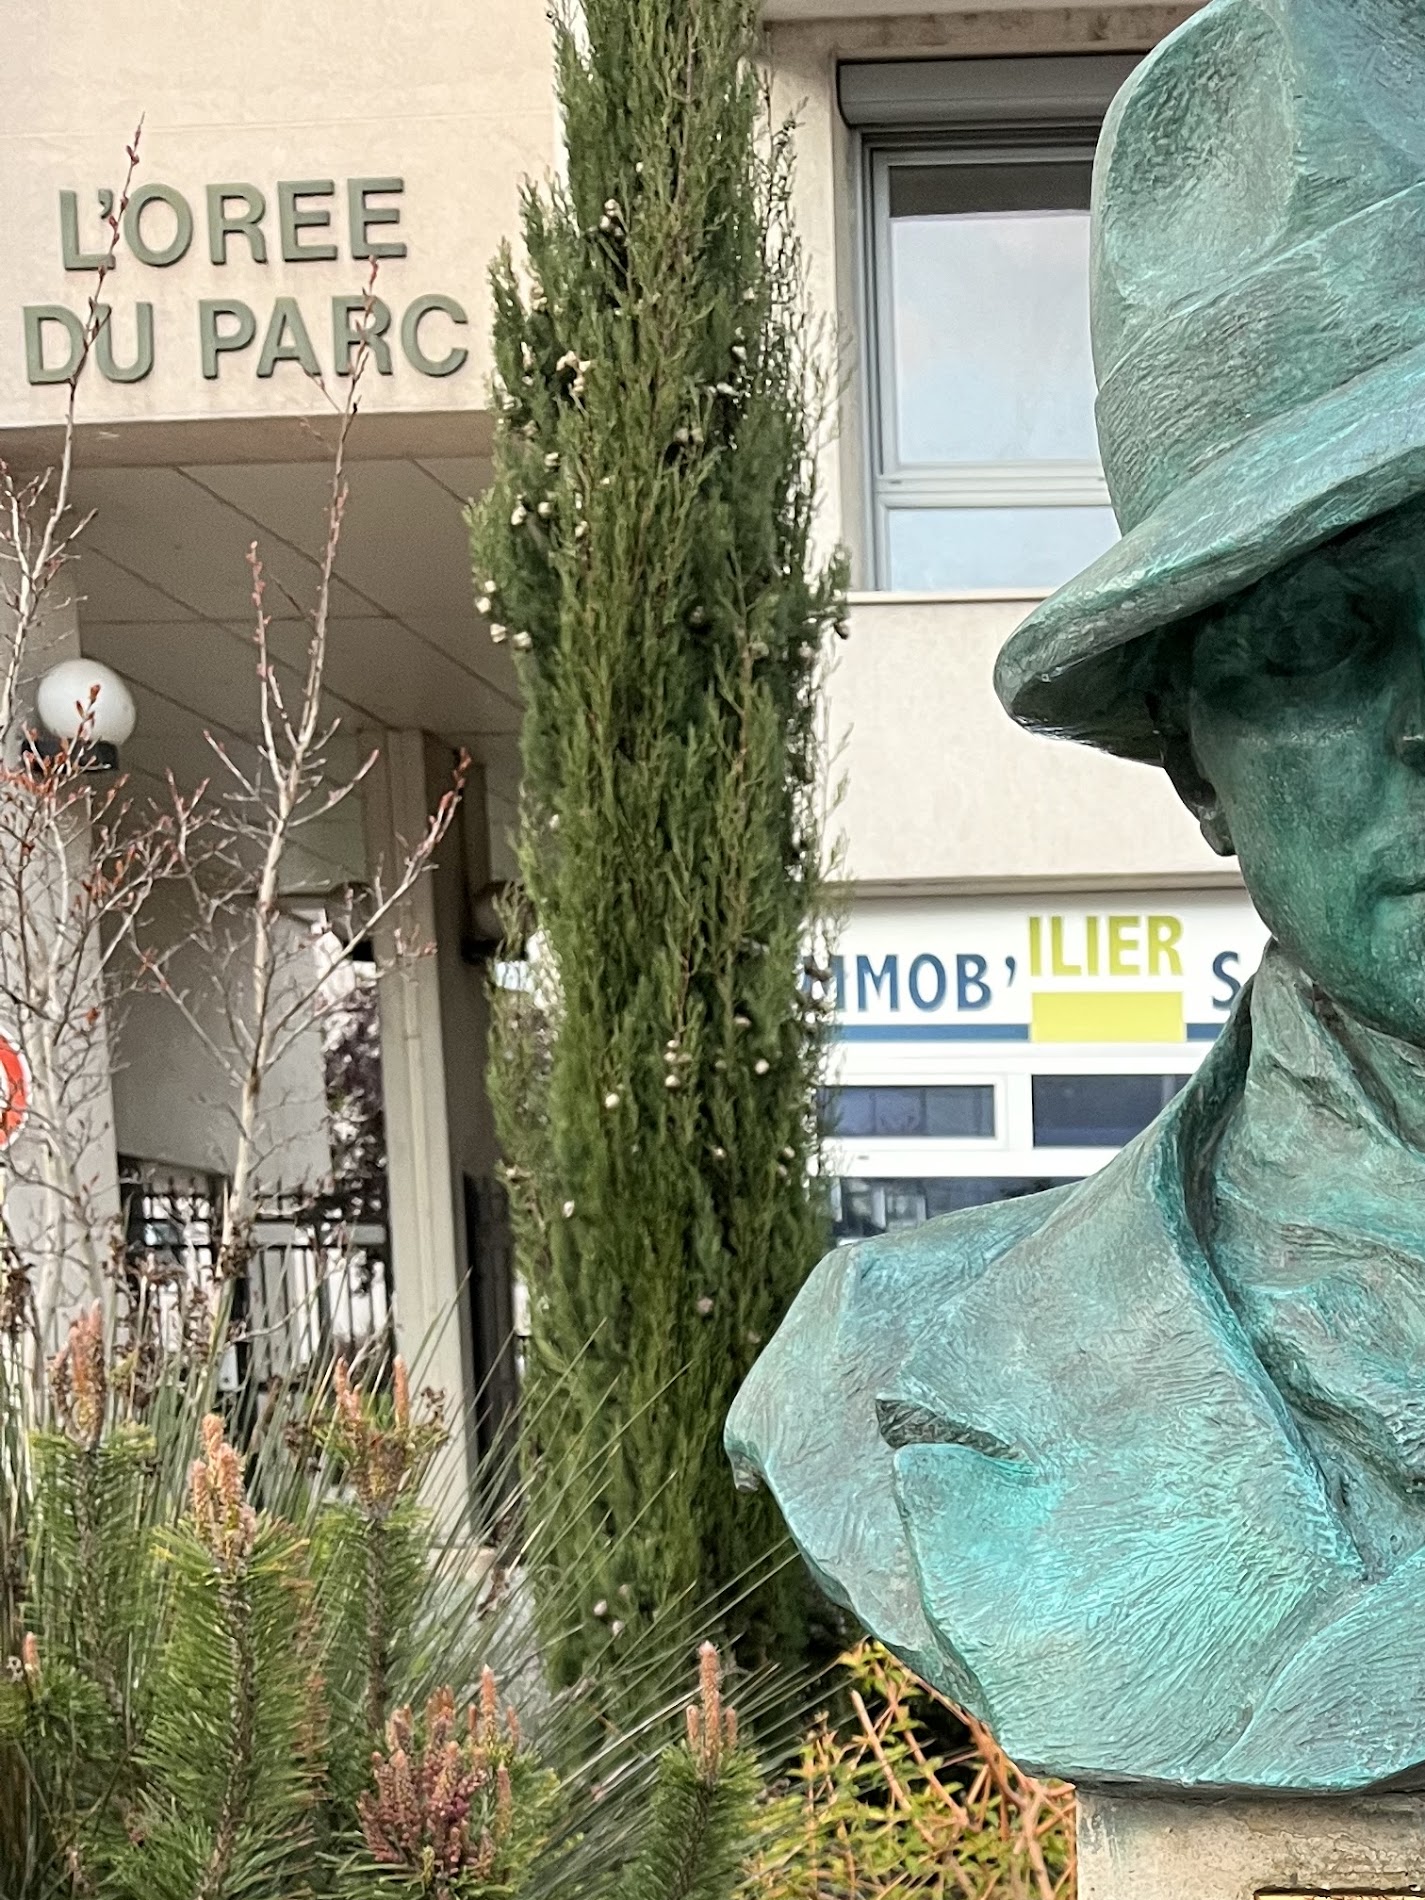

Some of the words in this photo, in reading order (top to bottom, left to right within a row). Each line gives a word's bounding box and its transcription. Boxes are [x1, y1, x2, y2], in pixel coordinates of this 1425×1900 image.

[58, 176, 408, 271] L'OREE
[22, 301, 154, 384] DU
[199, 292, 469, 379] PARC
